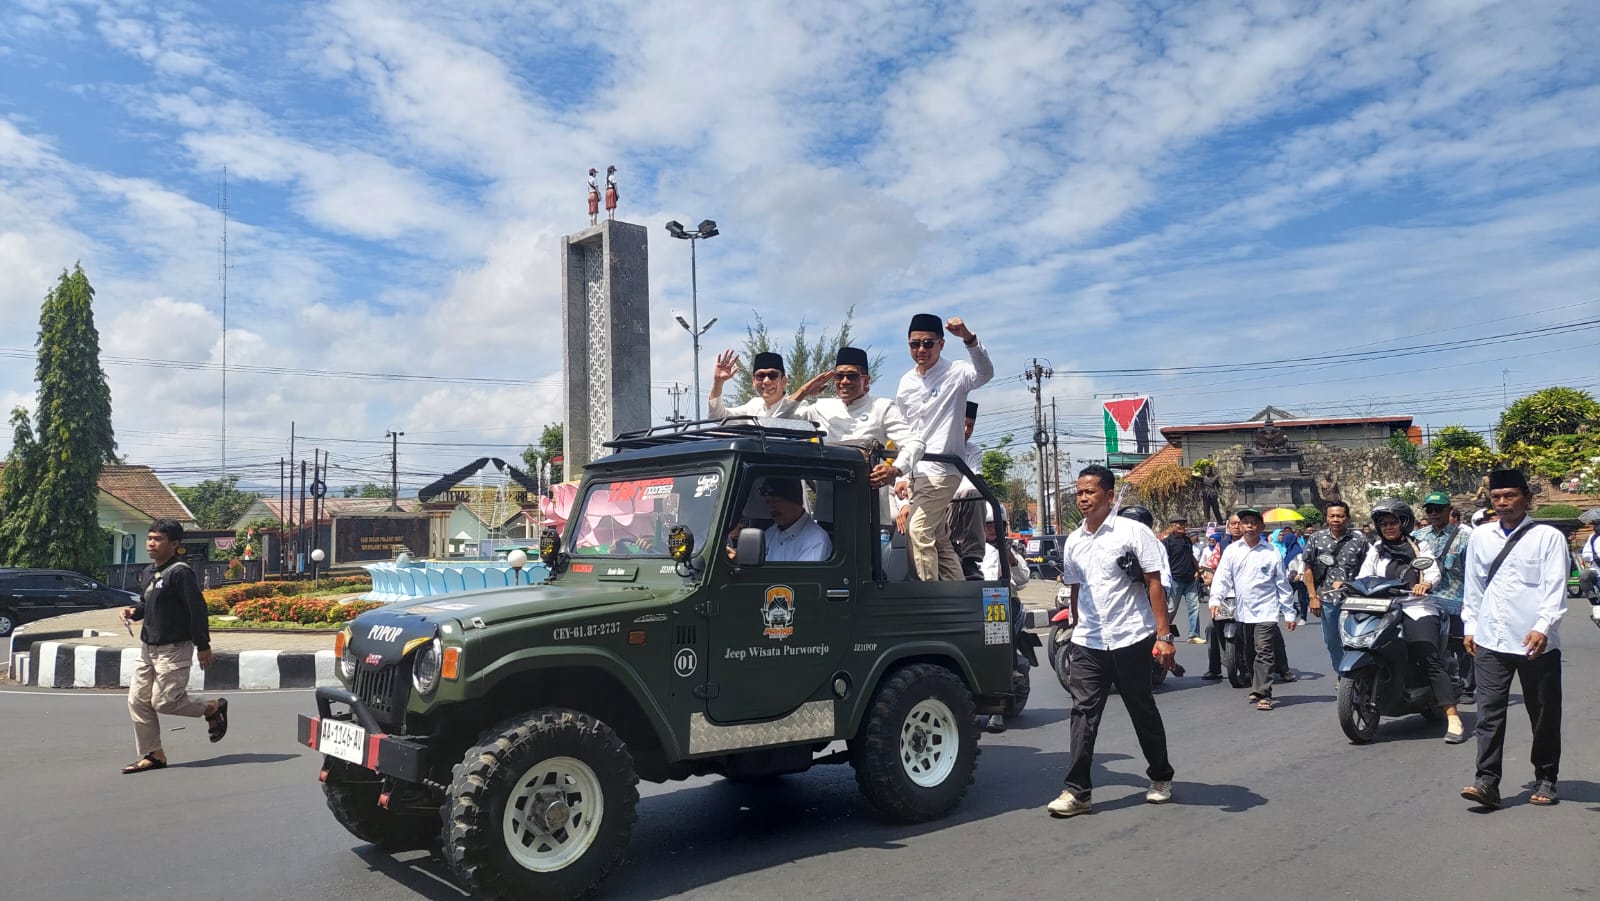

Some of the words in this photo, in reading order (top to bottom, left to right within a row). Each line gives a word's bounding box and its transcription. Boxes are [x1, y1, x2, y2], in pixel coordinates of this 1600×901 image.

[367, 624, 403, 642] POPOP
[725, 648, 746, 661] Jeep
[749, 647, 781, 657] Wisata
[783, 643, 829, 656] Purworejo
[677, 654, 694, 670] 01
